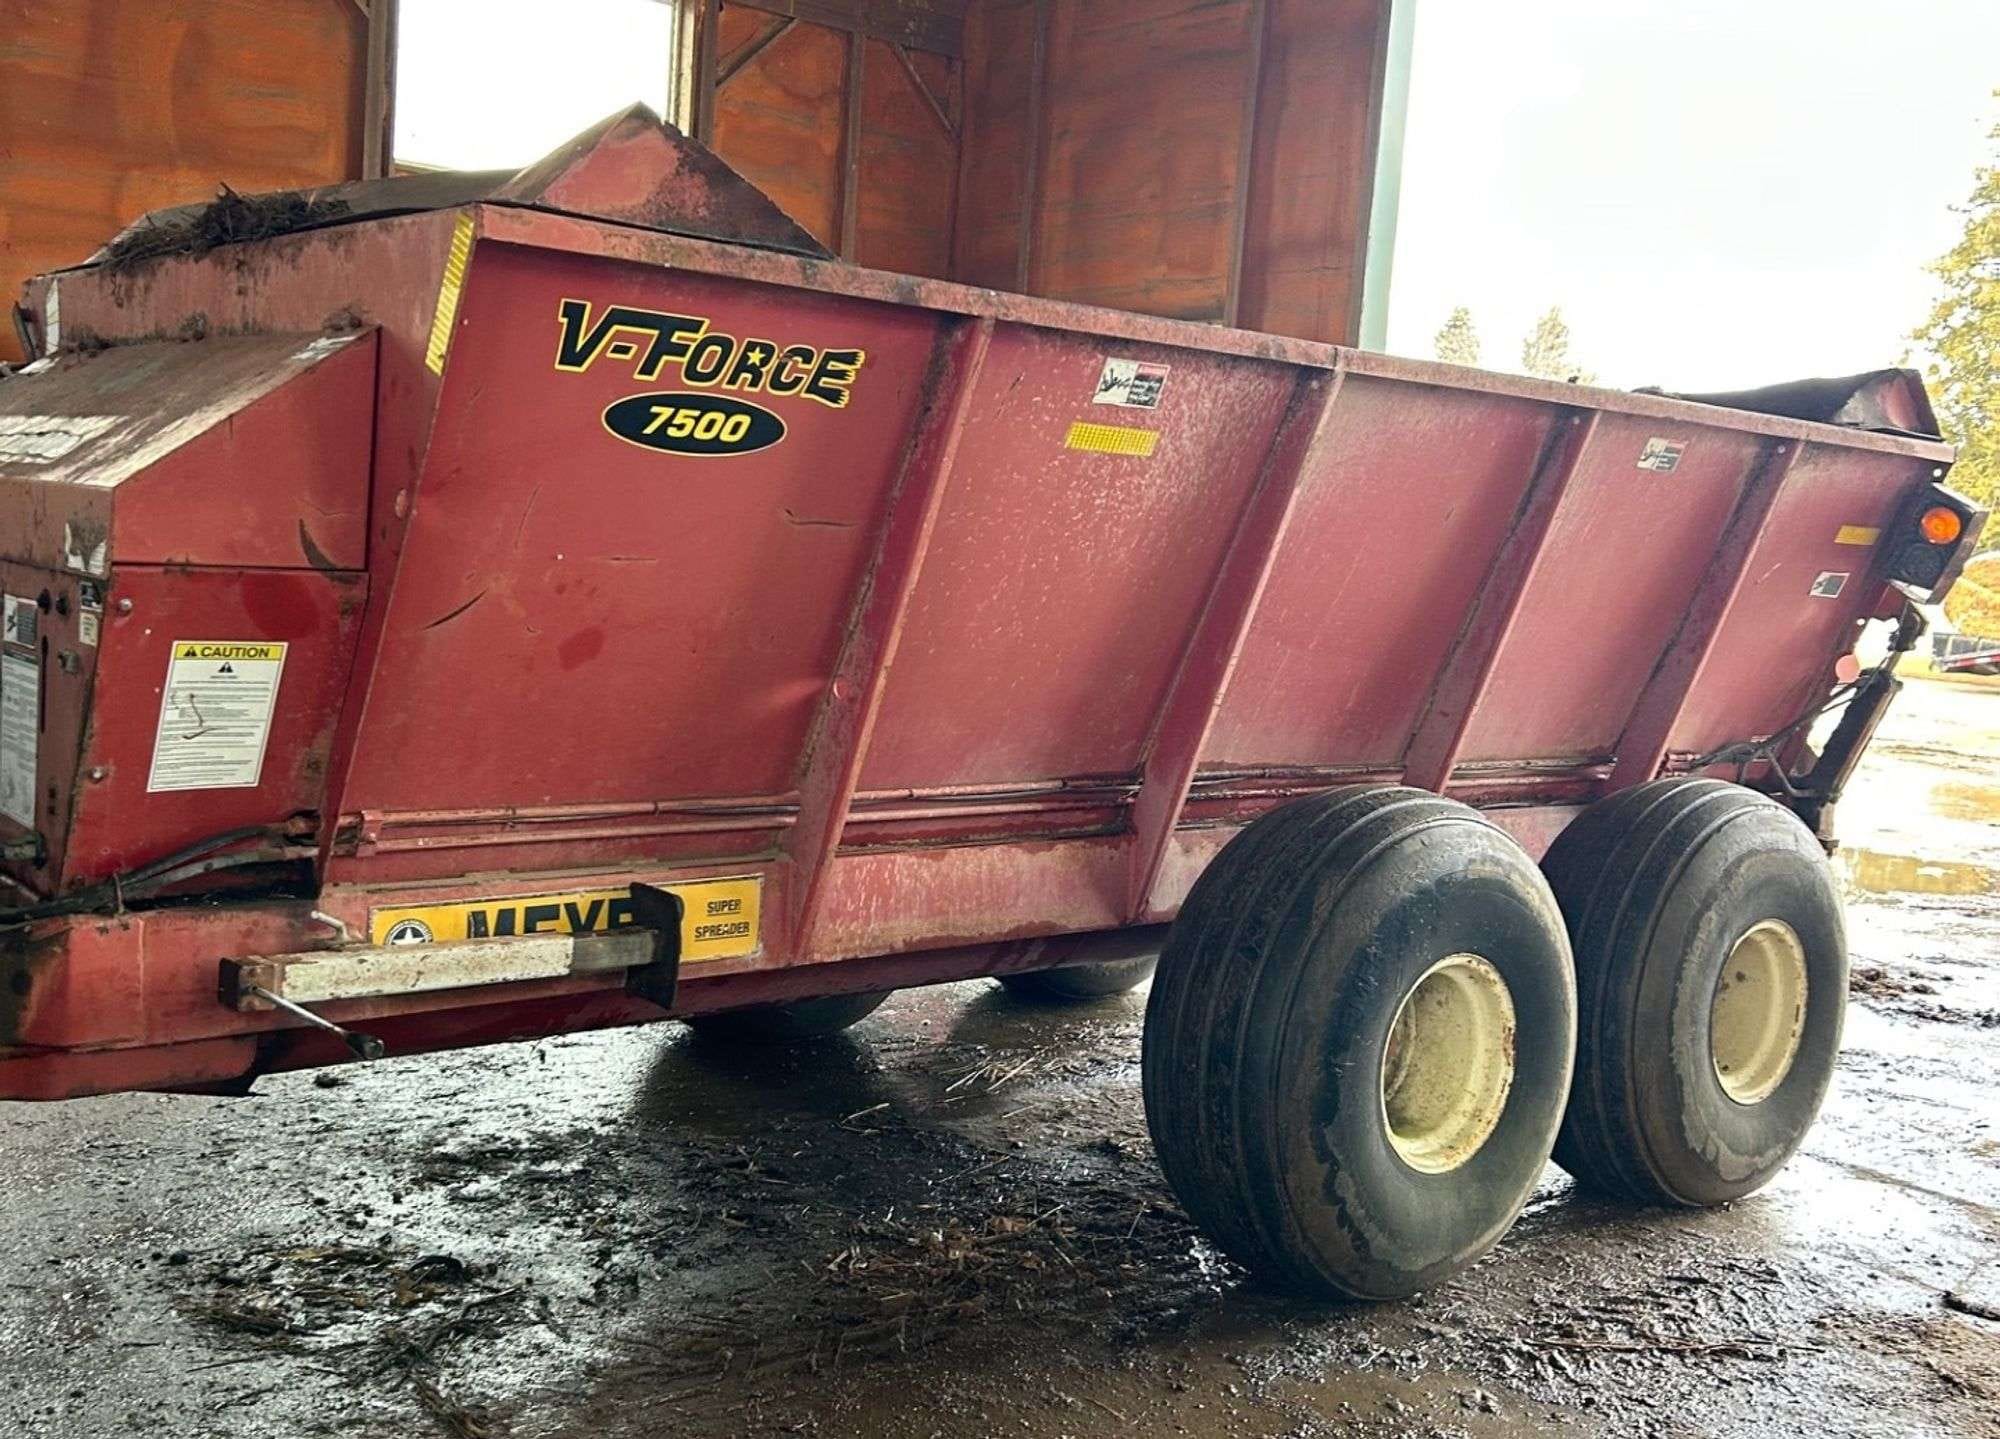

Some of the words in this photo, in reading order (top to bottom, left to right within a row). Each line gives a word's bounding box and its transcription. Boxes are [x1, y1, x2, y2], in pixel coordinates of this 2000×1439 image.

[554, 298, 865, 408] V-FORCE
[642, 405, 752, 443] 7500
[201, 646, 269, 658] CAUTION
[707, 898, 742, 914] SUPER
[694, 921, 750, 939] SPREADER
